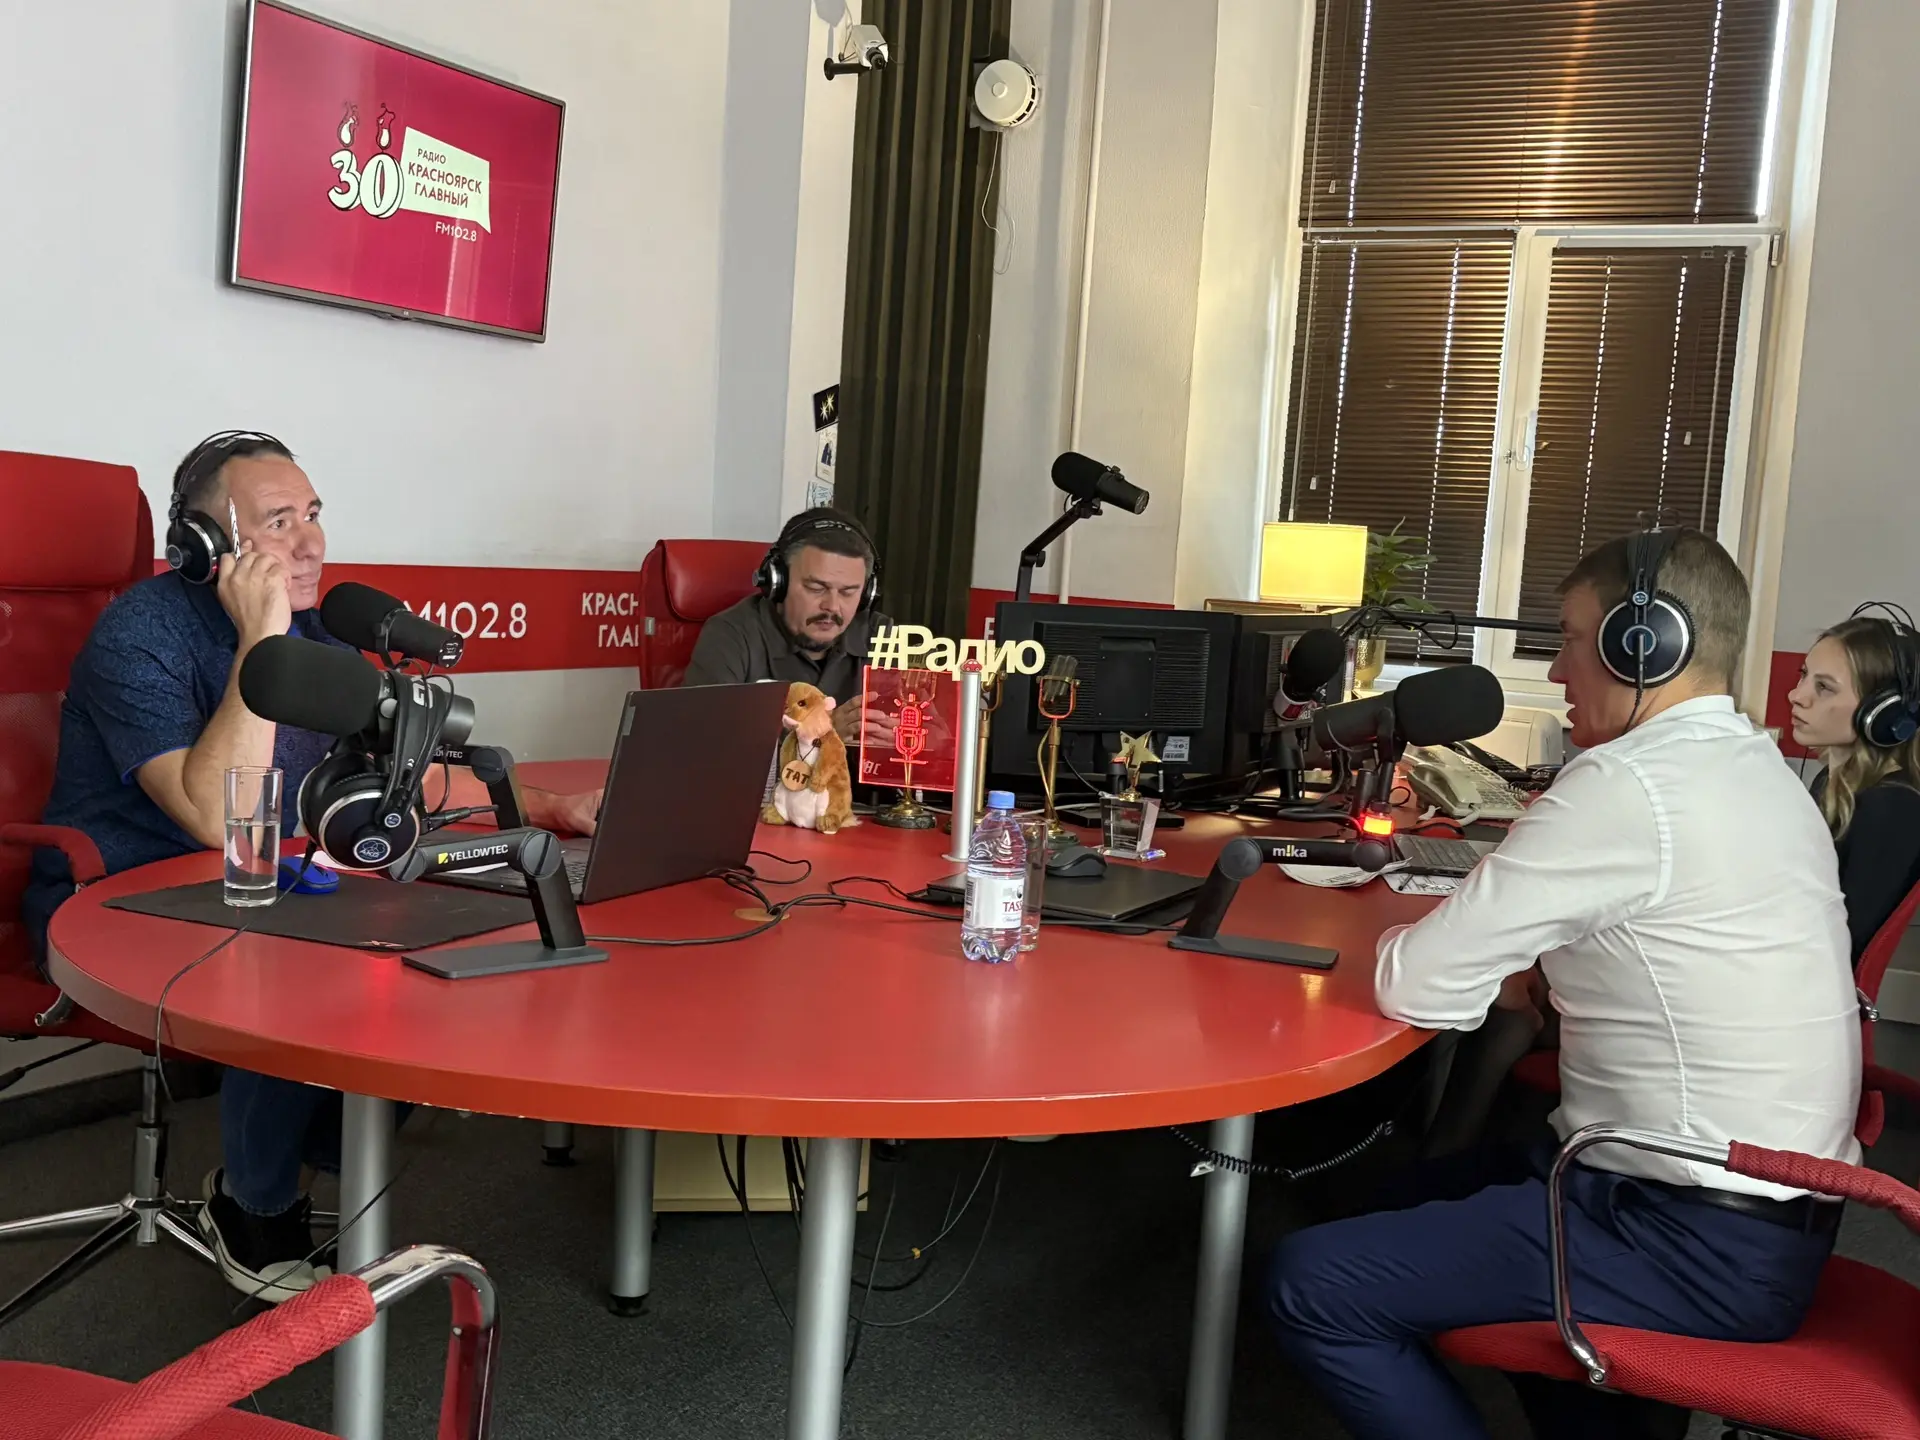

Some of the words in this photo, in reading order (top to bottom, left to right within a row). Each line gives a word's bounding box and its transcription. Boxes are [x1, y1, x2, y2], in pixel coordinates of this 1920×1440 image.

[417, 148, 446, 164] РАДИО
[327, 149, 405, 219] 30
[408, 161, 483, 194] КРАСНОЯРСК
[414, 182, 469, 208] ГЛАВНЫЙ
[435, 221, 477, 242] FM102.8
[867, 624, 1046, 681] #Радио
[449, 843, 509, 862] YELLOWTEC
